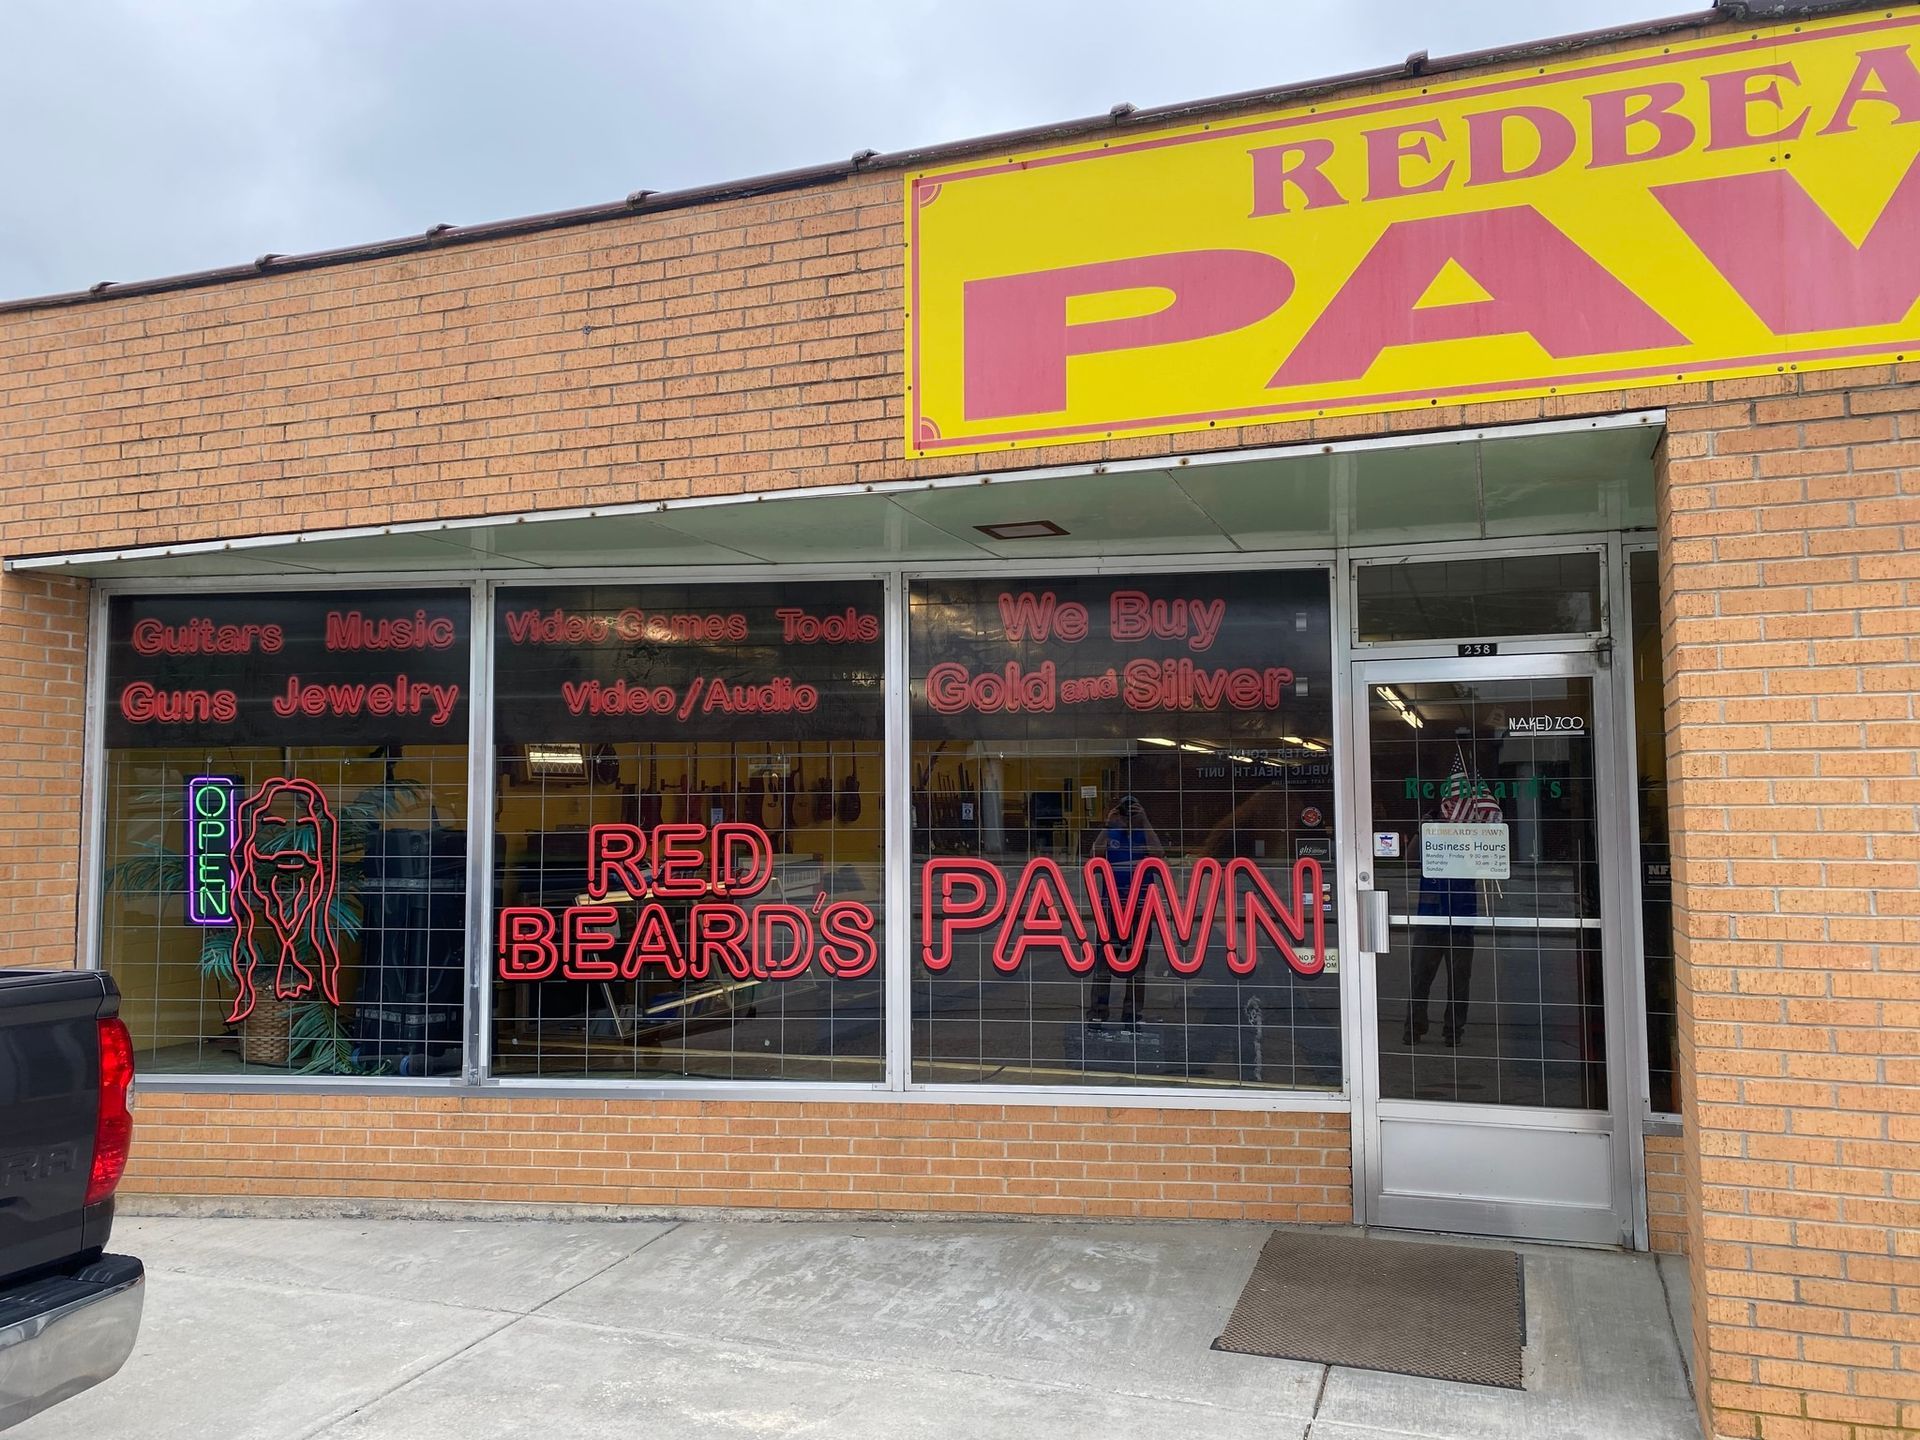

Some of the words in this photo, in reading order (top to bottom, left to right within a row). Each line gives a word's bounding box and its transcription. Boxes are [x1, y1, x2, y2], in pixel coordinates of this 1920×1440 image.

[132, 618, 284, 656] Guitars
[325, 610, 454, 651] Music
[505, 609, 608, 645] Video
[616, 607, 748, 644] Games
[775, 607, 880, 645] Tools
[999, 591, 1089, 644] We
[1109, 590, 1226, 652] Buy
[1464, 644, 1491, 655] 238
[121, 681, 237, 723] Guns
[273, 675, 460, 727] Jewelry
[562, 677, 819, 722] Video/Audio
[926, 660, 1056, 714] Gold
[1060, 668, 1118, 705] and
[1123, 657, 1293, 711] Silver
[1508, 715, 1552, 736] NAKED
[1554, 716, 1584, 729] ZOO
[1405, 775, 1562, 799] Redbeard's
[195, 785, 226, 915] OPEN
[587, 823, 773, 898] RED
[1425, 841, 1470, 851] Business
[1474, 841, 1506, 851] Hours
[500, 892, 878, 980] BEARD'S
[922, 857, 1325, 975] PAWN
